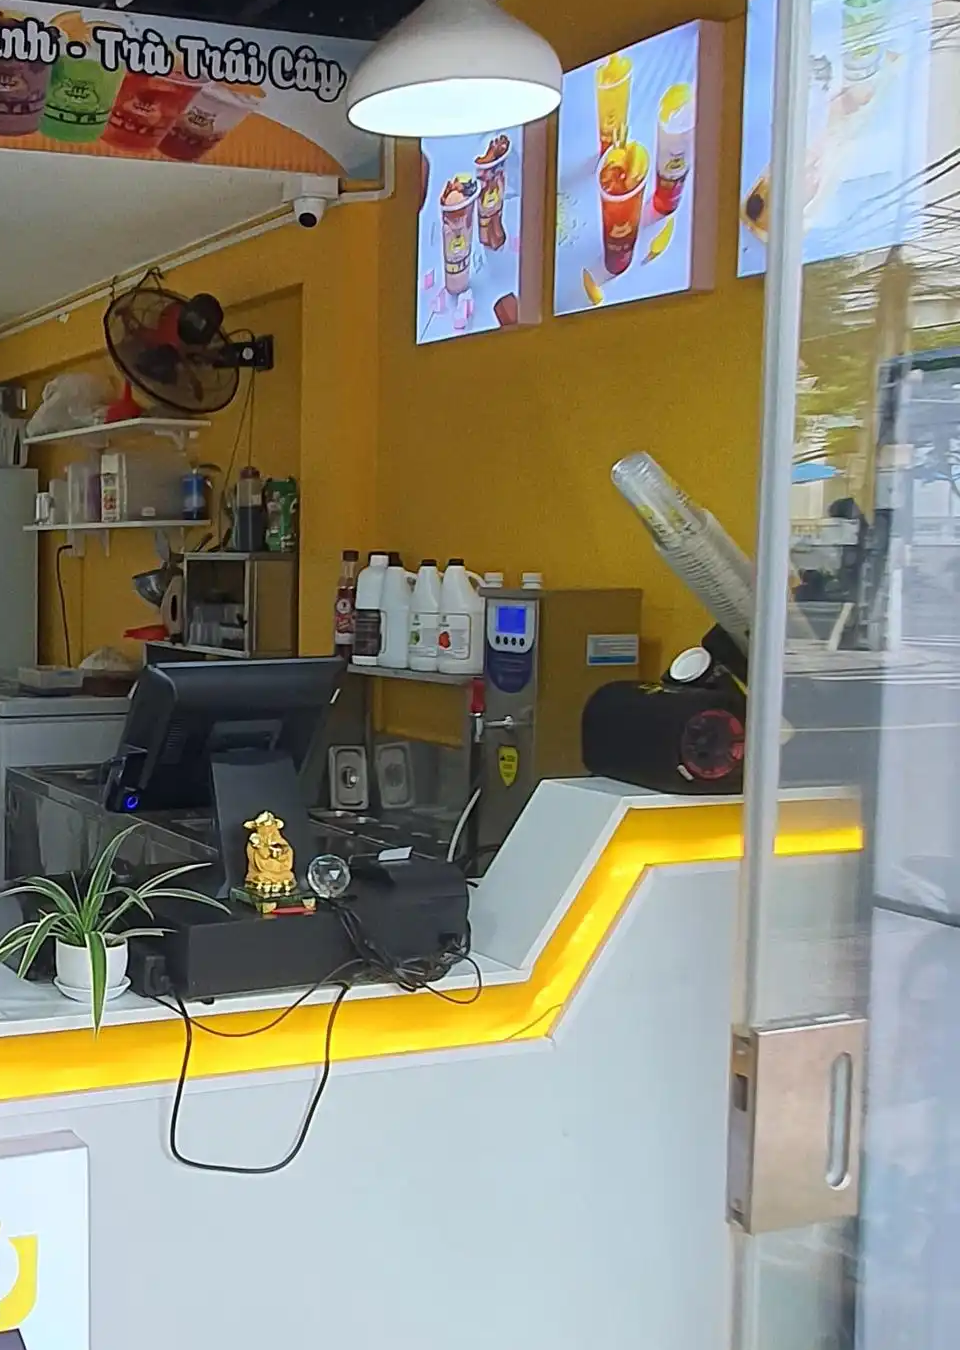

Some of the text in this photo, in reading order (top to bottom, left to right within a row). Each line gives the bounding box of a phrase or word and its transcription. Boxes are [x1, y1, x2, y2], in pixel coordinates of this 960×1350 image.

[93, 26, 174, 75] Trà
[176, 34, 267, 85] Trái
[268, 45, 347, 102] Cây
